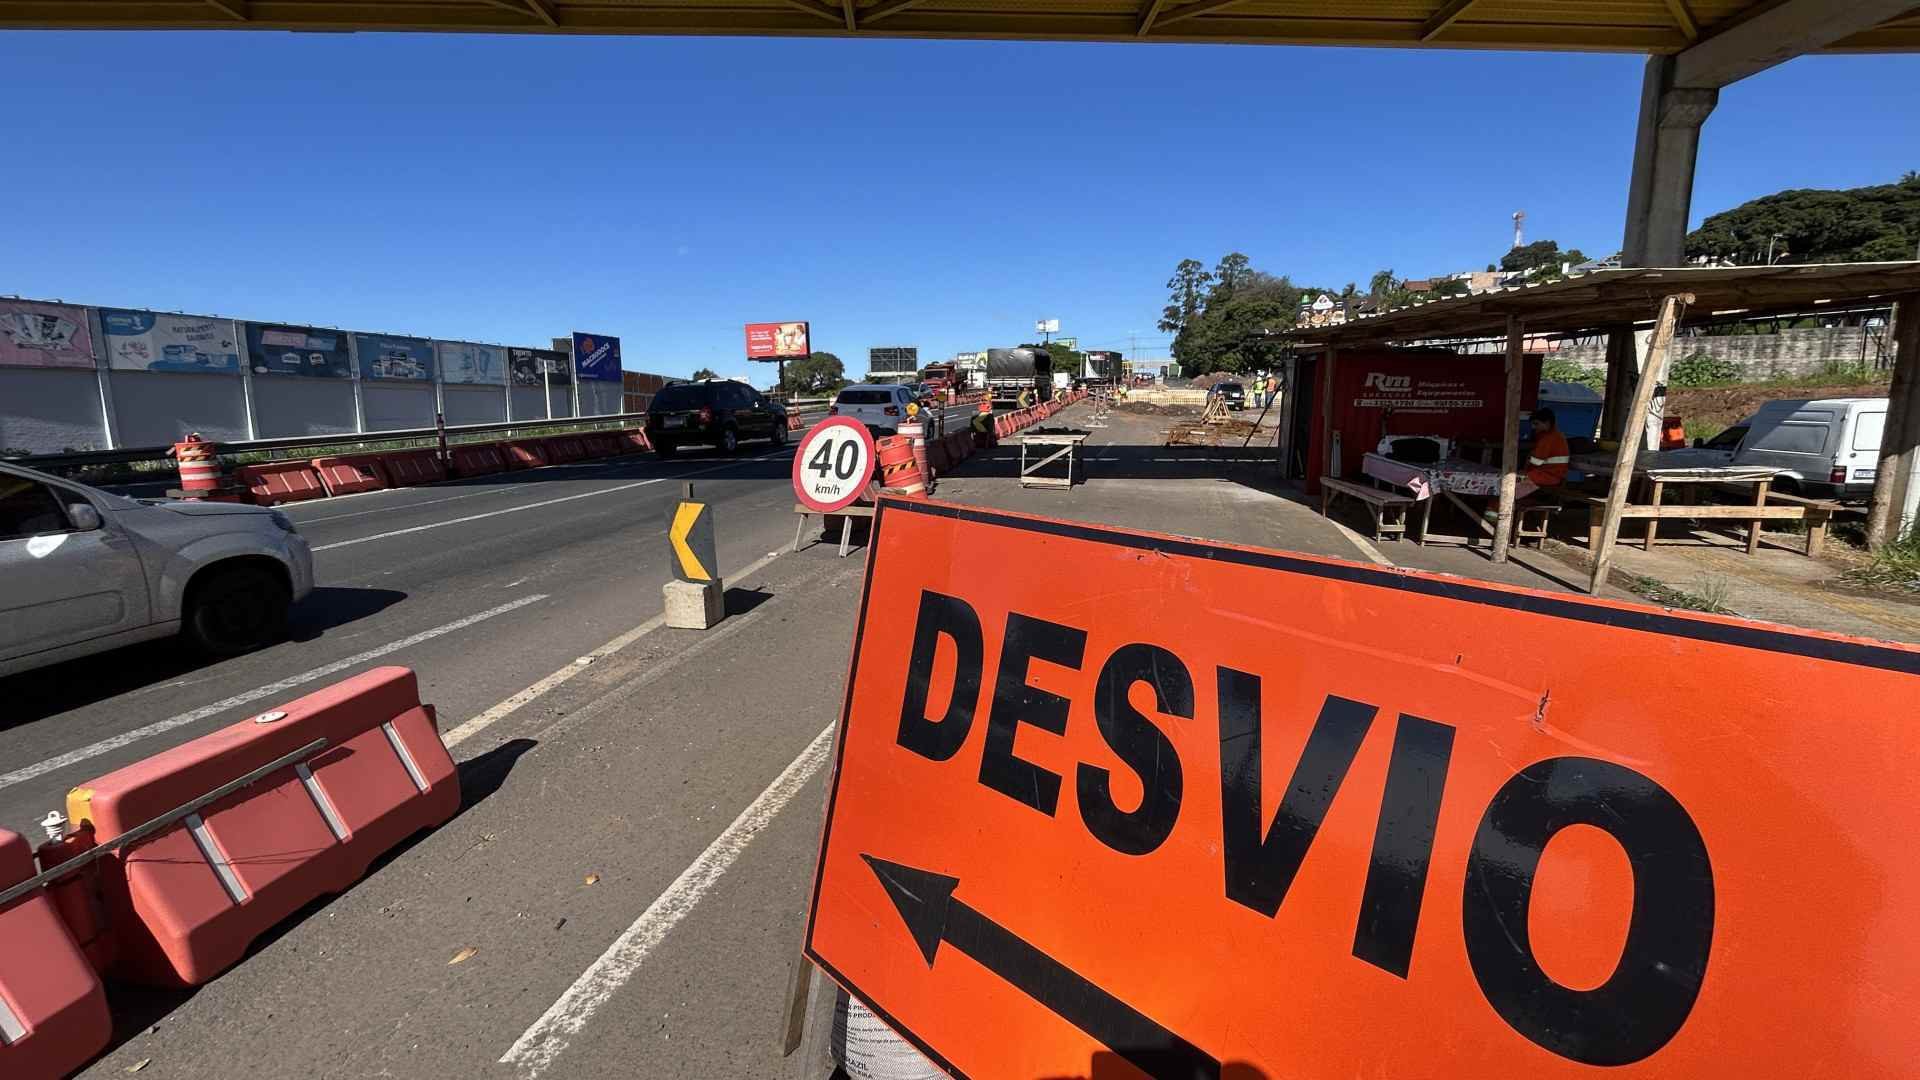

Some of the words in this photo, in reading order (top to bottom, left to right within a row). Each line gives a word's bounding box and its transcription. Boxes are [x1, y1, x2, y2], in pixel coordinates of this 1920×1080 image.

[808, 438, 859, 480] 40
[814, 483, 840, 495] km/h
[895, 588, 1716, 1068] DESVIO
